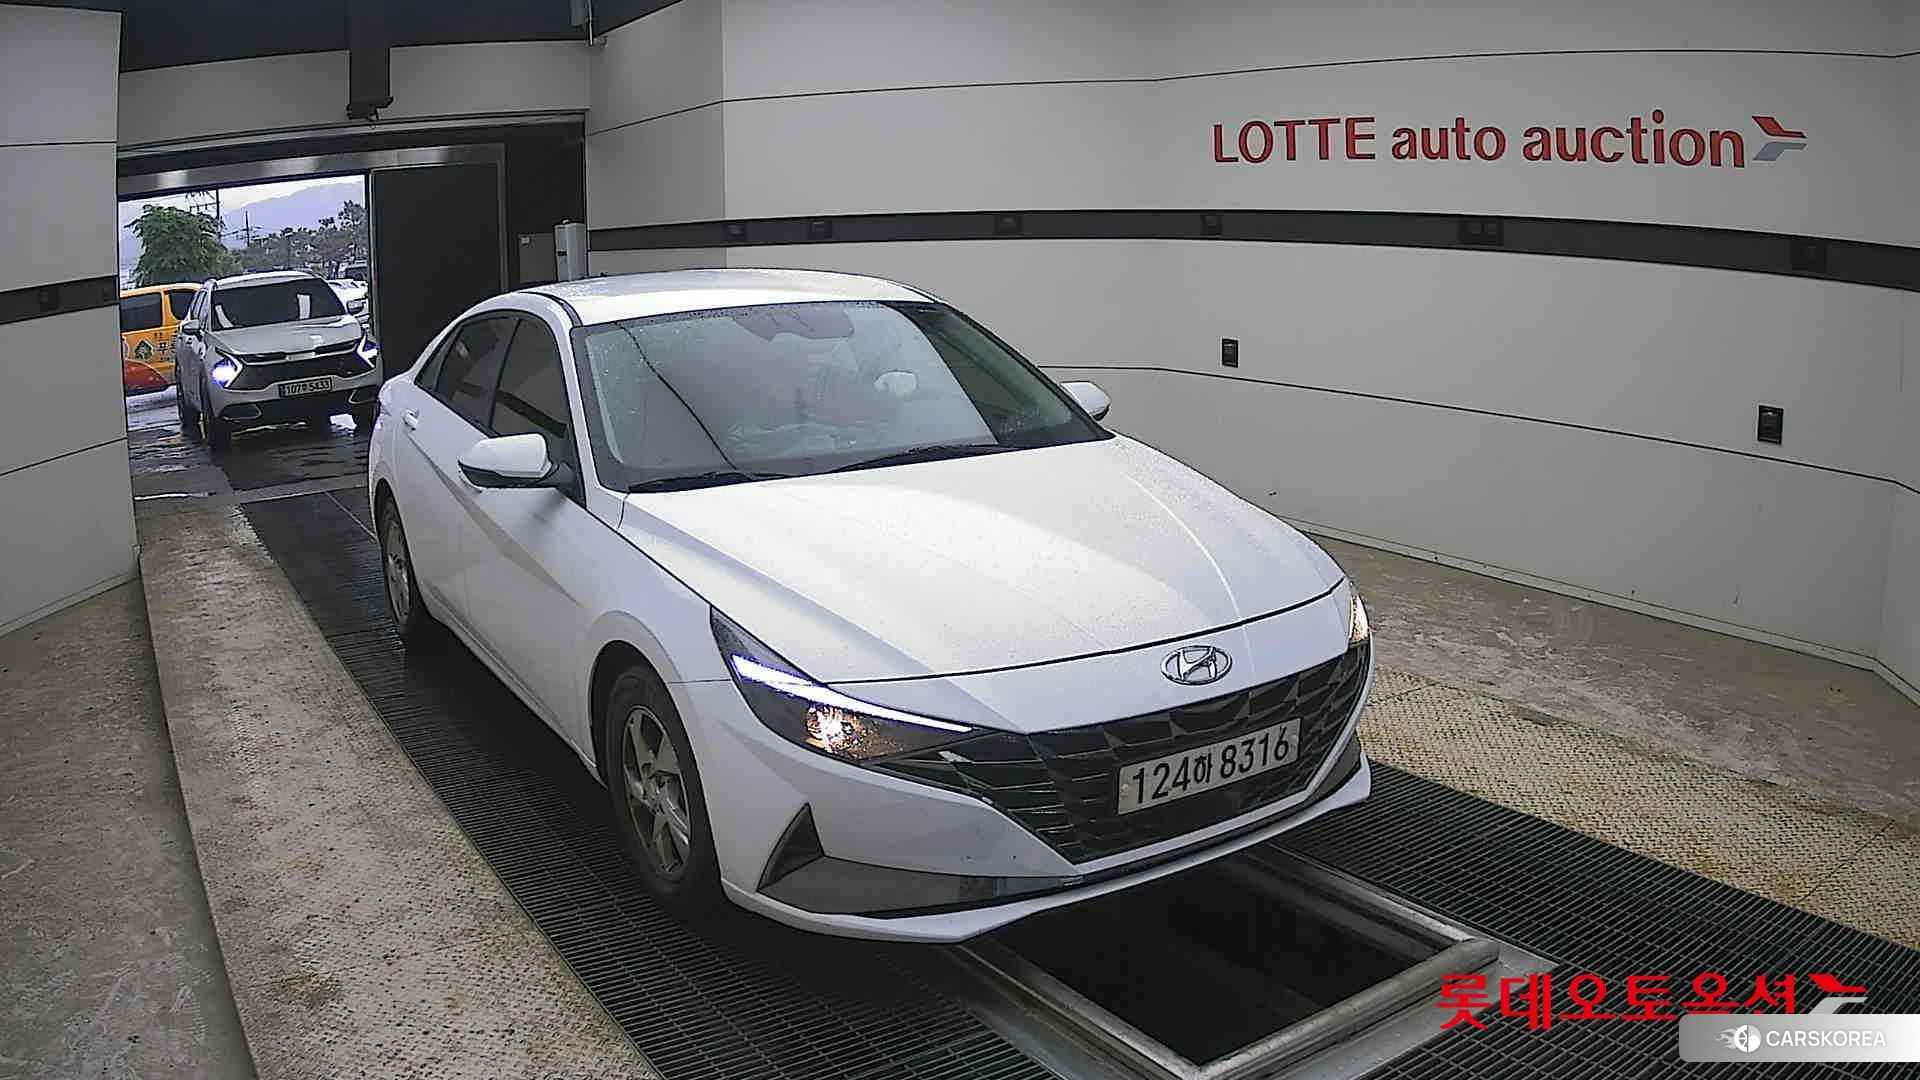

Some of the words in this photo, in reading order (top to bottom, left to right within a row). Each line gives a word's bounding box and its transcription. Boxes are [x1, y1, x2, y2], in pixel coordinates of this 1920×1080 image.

[1213, 116, 1376, 163] LOTTE
[1391, 118, 1507, 161] auto
[1522, 109, 1745, 168] auction
[1132, 753, 1212, 804] 124하
[1220, 726, 1289, 778] 8316
